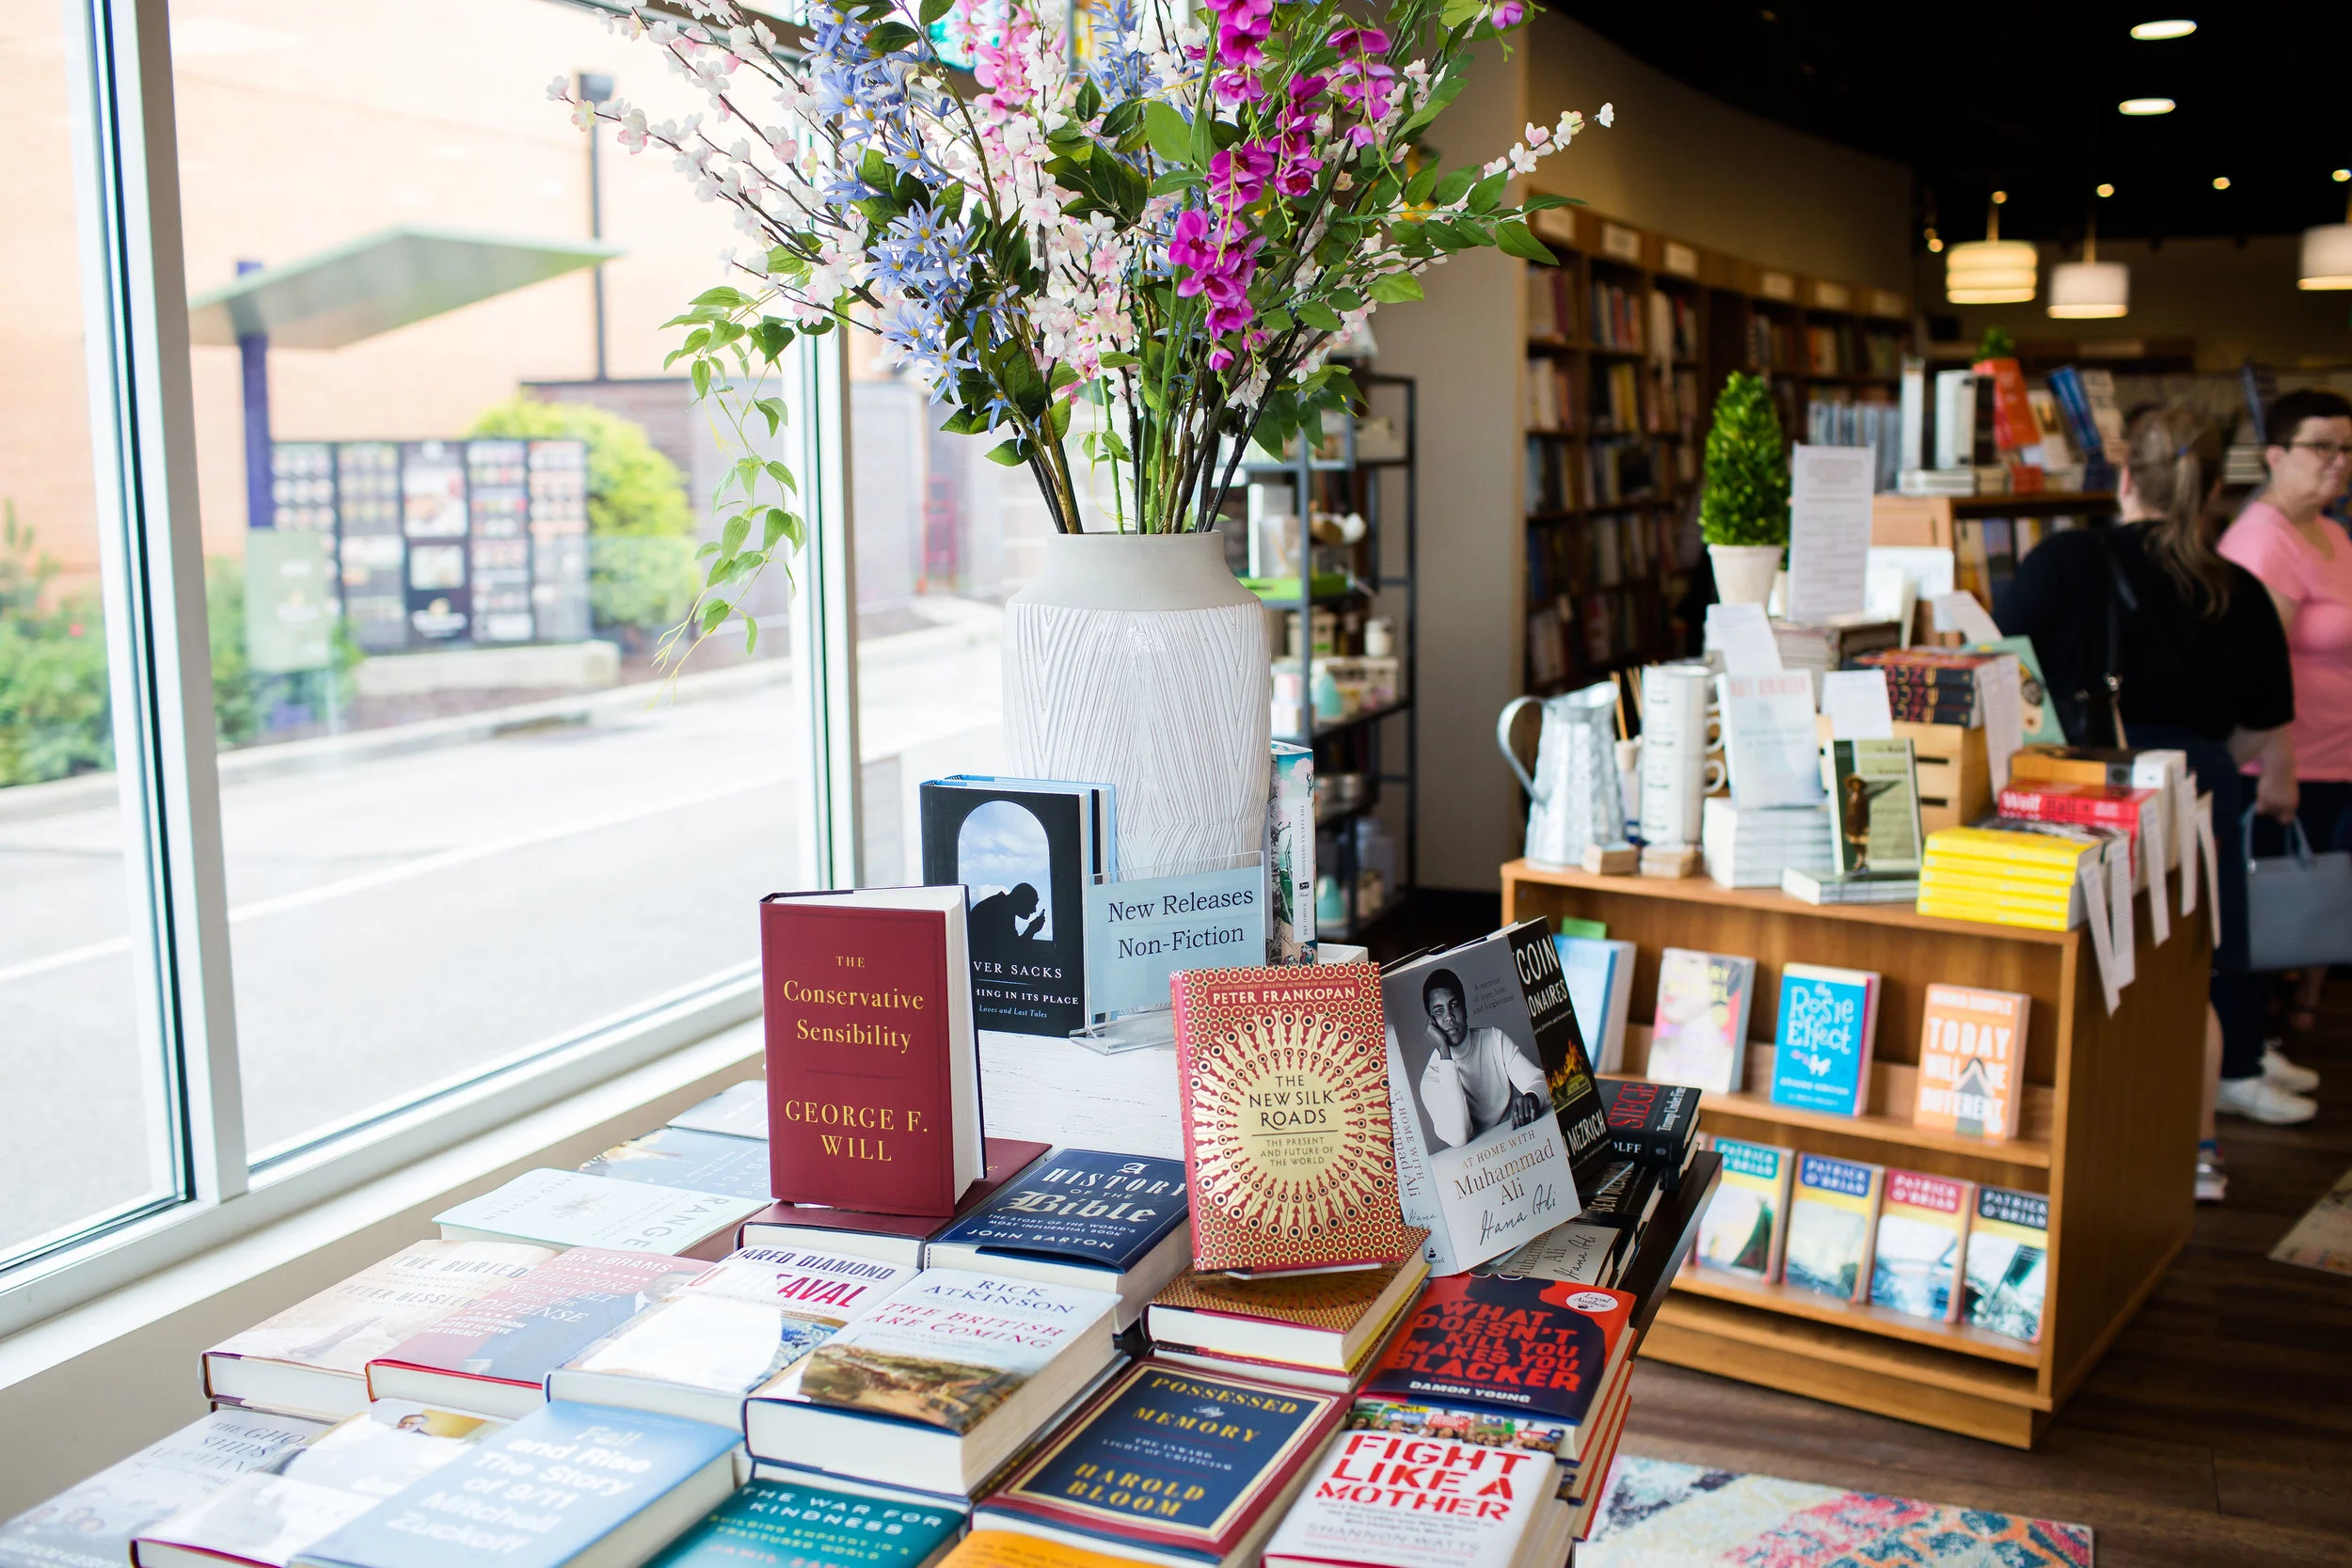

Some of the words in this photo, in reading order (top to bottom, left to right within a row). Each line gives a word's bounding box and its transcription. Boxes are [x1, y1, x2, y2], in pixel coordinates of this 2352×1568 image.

[1107, 902, 1155, 924] New
[1163, 889, 1253, 916] Releases
[1118, 927, 1244, 959] Non-Fiction
[836, 957, 866, 968] THE
[973, 960, 1002, 974] VER
[1011, 964, 1062, 979] SACKS
[1516, 935, 1559, 985] COIN
[784, 980, 924, 1010] Conservative
[1005, 991, 1018, 1001] IN
[1022, 992, 1040, 1002] ITS
[1042, 994, 1079, 1005] PLACE
[1213, 991, 1257, 1005] PETER
[1263, 988, 1356, 1003] FRANKOPAN
[1789, 986, 1853, 1025] Rosie
[978, 1005, 999, 1015] Loves
[1013, 1007, 1028, 1017] Last
[1028, 1008, 1048, 1019] Tales
[797, 1019, 911, 1053] Sensibility
[1787, 1016, 1852, 1054] Effect
[1930, 1018, 2011, 1060] TODAY
[1275, 1074, 1305, 1087] THE
[1249, 1092, 1293, 1108] NEW
[1296, 1090, 1335, 1104] SILK
[1607, 1083, 1659, 1130] SIEGE
[786, 1100, 894, 1131] GEORGE
[908, 1111, 929, 1132] F.
[1261, 1109, 1327, 1130] ROADS
[1287, 1137, 1325, 1146] PRESENT
[1393, 1089, 1404, 1104] AT
[1399, 1107, 1415, 1144] HOME
[1409, 1147, 1425, 1180] WITH
[1570, 1113, 1606, 1156] MEZRICH
[820, 1134, 892, 1162] WILL
[1260, 1148, 1282, 1157] AND
[1284, 1148, 1321, 1157] FUTURE
[1286, 1157, 1325, 1165] WORLD
[1461, 1157, 1474, 1169] AT
[1476, 1142, 1507, 1164] HOME
[1508, 1130, 1536, 1148] WITH
[1719, 1143, 1774, 1164] PATRICK
[1041, 1167, 1187, 1196] HISTORY
[1117, 1163, 1151, 1175] A
[1453, 1138, 1555, 1200] Muhammad
[1806, 1160, 1866, 1181] PATRICK
[1405, 1174, 1422, 1197] Ali
[1501, 1177, 1525, 1206] Ali
[1804, 1172, 1866, 1195] O'BRIAN
[1894, 1175, 1957, 1198] PATRICK
[997, 1191, 1157, 1223] Bible
[1587, 1196, 1619, 1212] BEN
[1892, 1187, 1956, 1211] O'BRIAN
[1984, 1190, 2048, 1215] PATRICK
[623, 1196, 729, 1249] RANGE
[1009, 1216, 1044, 1225] STORY
[1089, 1224, 1136, 1233] WORLD'S
[1408, 1209, 1438, 1223] Hana
[1480, 1210, 1528, 1246] Hana
[1533, 1183, 1557, 1215] Ali
[966, 1229, 1024, 1240] JOHN
[1032, 1234, 1115, 1250] BARTON
[1022, 1222, 1086, 1233] INFLUENTIAL
[1090, 1228, 1122, 1237] BOOK
[392, 1256, 437, 1270] THE
[441, 1260, 531, 1279] BURIED
[595, 1257, 674, 1273] ABRAMS
[728, 1249, 796, 1264] JARED
[796, 1255, 896, 1280] DIAMOND
[1542, 1248, 1567, 1262] Ali
[504, 1280, 622, 1304] ROOSEVELT
[525, 1271, 642, 1292] THEODORE
[977, 1279, 1049, 1297] RICK
[336, 1285, 395, 1300] PETER
[396, 1291, 476, 1308] HESSLER
[516, 1293, 552, 1303] FOR
[922, 1286, 1076, 1314] ATKINSON
[472, 1299, 590, 1323] DEFENSE
[882, 1303, 942, 1316] THE
[946, 1312, 1066, 1337] BRITISH
[1441, 1301, 1553, 1327] WHAT
[444, 1327, 485, 1338] LEGACY
[486, 1325, 516, 1335] SAVE
[864, 1314, 924, 1326] ARE
[930, 1323, 1053, 1349] COMING
[1412, 1314, 1578, 1344] DOESN'T
[1404, 1340, 1509, 1364] MAKES
[1519, 1354, 1580, 1371] YOU
[1444, 1332, 1507, 1350] KILL
[1520, 1341, 1579, 1358] YOU
[1389, 1353, 1581, 1392] BLACKER
[1151, 1377, 1298, 1415] POSSESSED
[1409, 1381, 1470, 1395] DAMON
[1475, 1388, 1531, 1403] YOUNG
[211, 1421, 243, 1433] THE
[575, 1425, 643, 1447] Fall
[1133, 1406, 1261, 1443] MEMORY
[203, 1436, 270, 1458] SHIPS
[506, 1438, 579, 1459] and
[574, 1448, 652, 1474] Rise
[1344, 1434, 1532, 1475] FIGHT
[473, 1450, 534, 1476] The
[537, 1465, 634, 1497] Story
[1074, 1463, 1205, 1502] HAROLD
[1331, 1459, 1468, 1494] LIKE
[1476, 1477, 1514, 1501] A
[463, 1478, 509, 1493] of
[502, 1482, 579, 1510] 9/11
[742, 1486, 796, 1502] THE
[810, 1497, 871, 1514] WAR
[882, 1509, 942, 1528] FOR
[1066, 1481, 1183, 1517] BLOOM
[1315, 1481, 1511, 1522] MOTHER
[420, 1491, 564, 1533] Mitchell
[750, 1502, 903, 1535] KINDNESS
